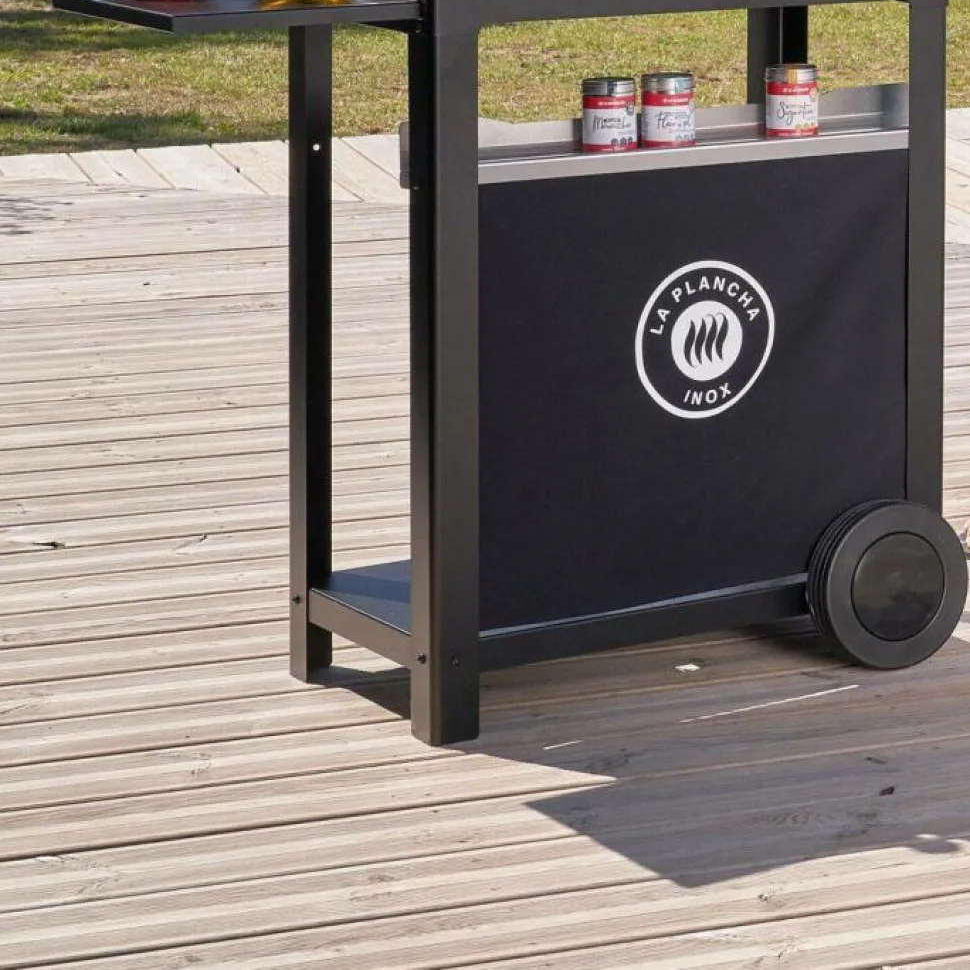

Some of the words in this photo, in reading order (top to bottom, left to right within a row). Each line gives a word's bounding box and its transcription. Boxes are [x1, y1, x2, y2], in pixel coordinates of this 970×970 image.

[650, 308, 671, 335] LA
[671, 276, 760, 321] PLANCHA
[683, 382, 732, 405] INOX
